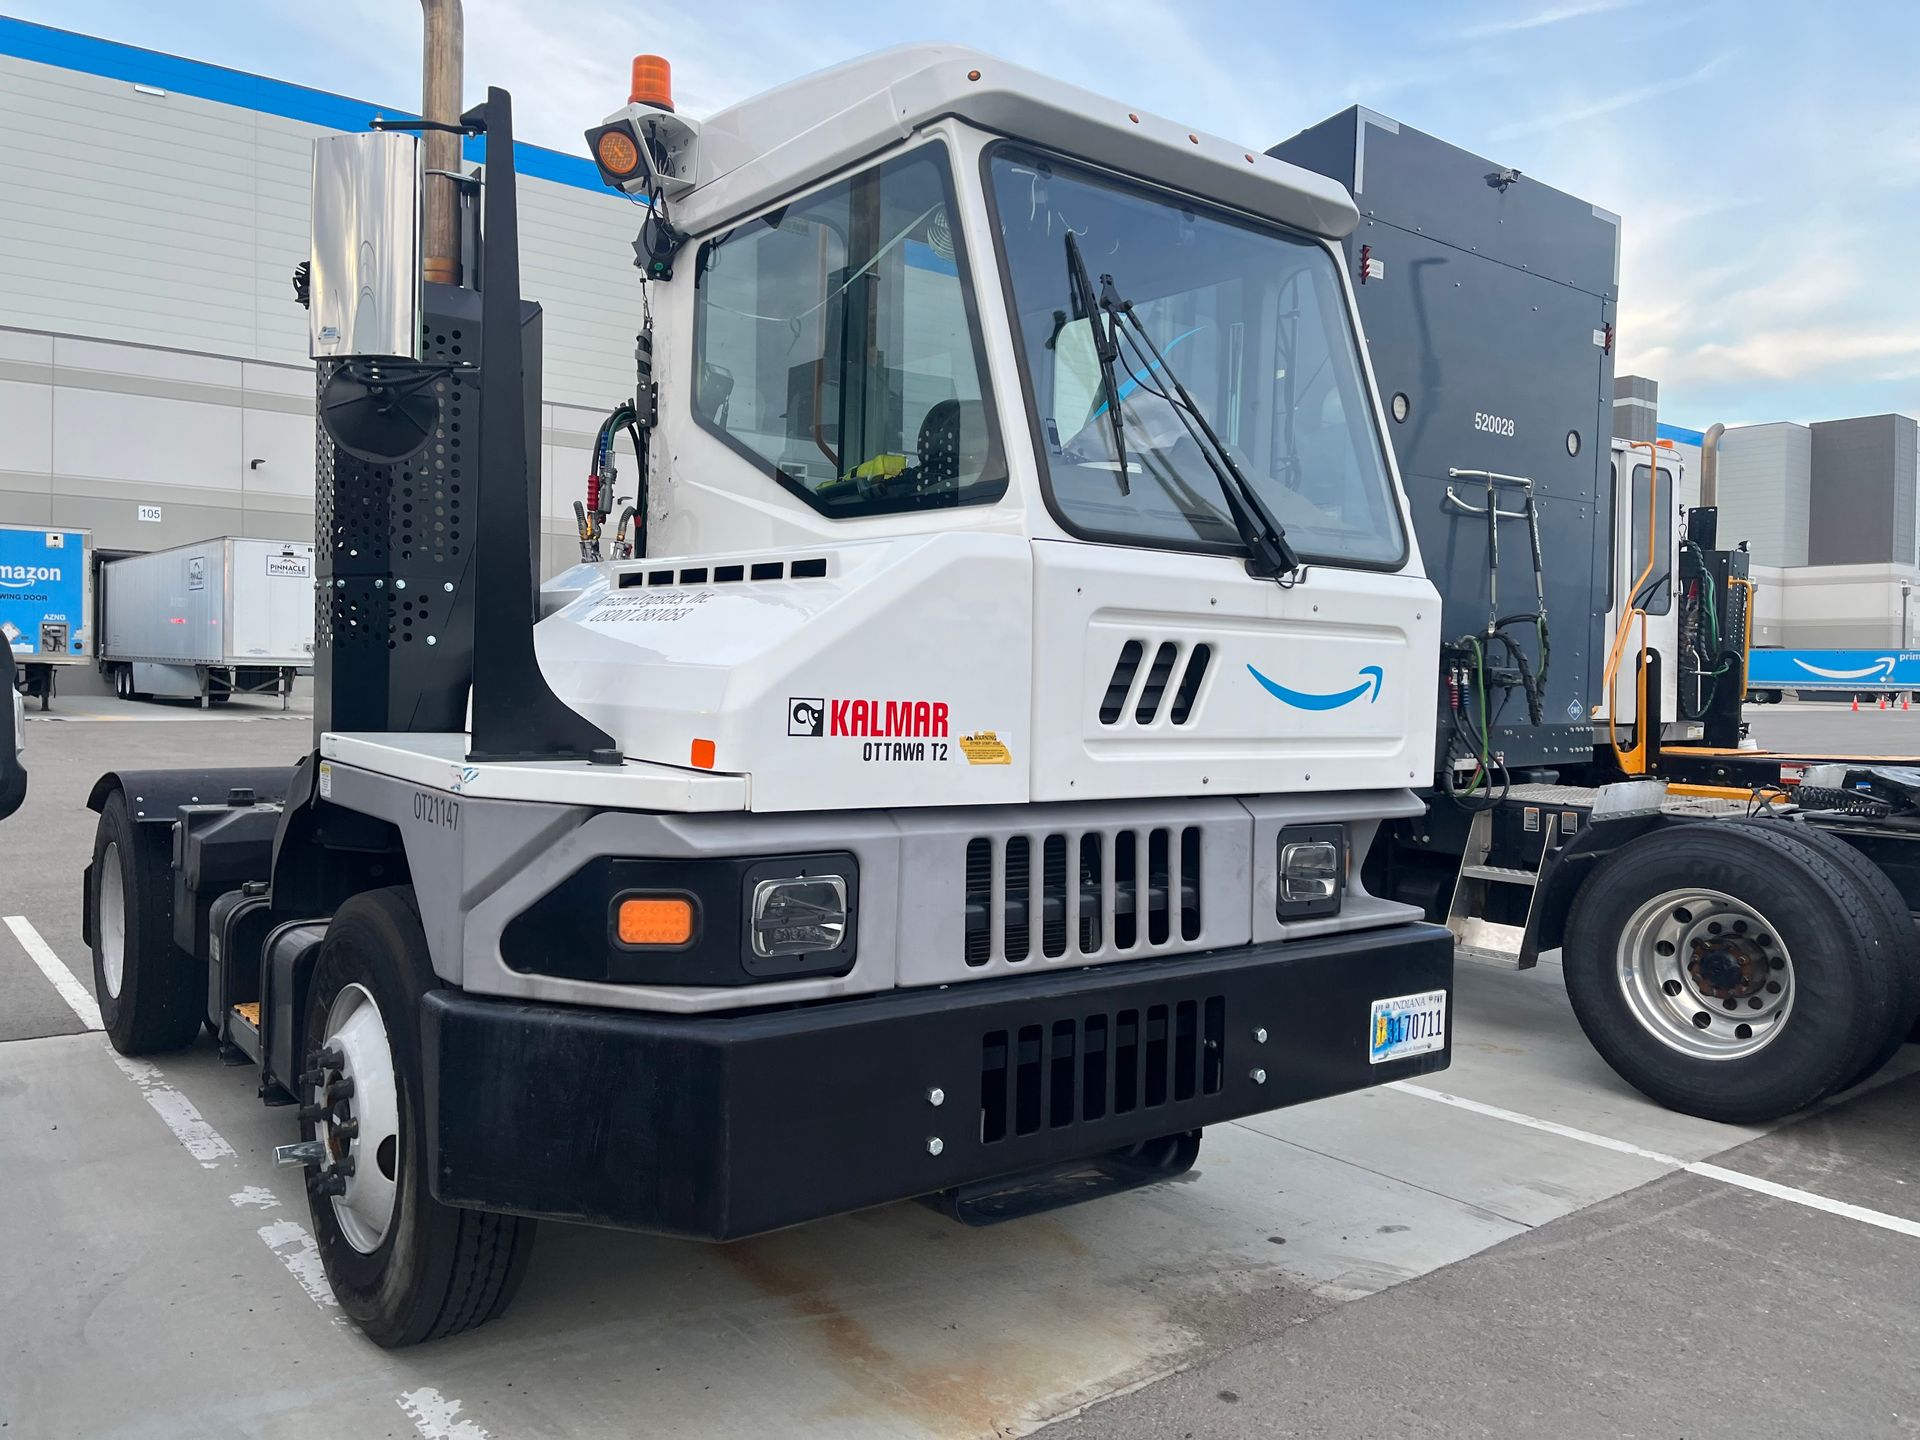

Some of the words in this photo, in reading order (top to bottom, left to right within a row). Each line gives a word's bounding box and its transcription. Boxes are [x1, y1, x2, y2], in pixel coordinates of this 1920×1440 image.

[1474, 412, 1515, 437] 520028
[142, 508, 161, 519] 105
[270, 563, 306, 573] PINNACLE
[830, 699, 949, 737] KALMAR
[863, 742, 925, 762] OTTAWA
[931, 743, 948, 761] T2
[1392, 997, 1426, 1011] INDIANA
[1387, 1009, 1442, 1045] 3170711
